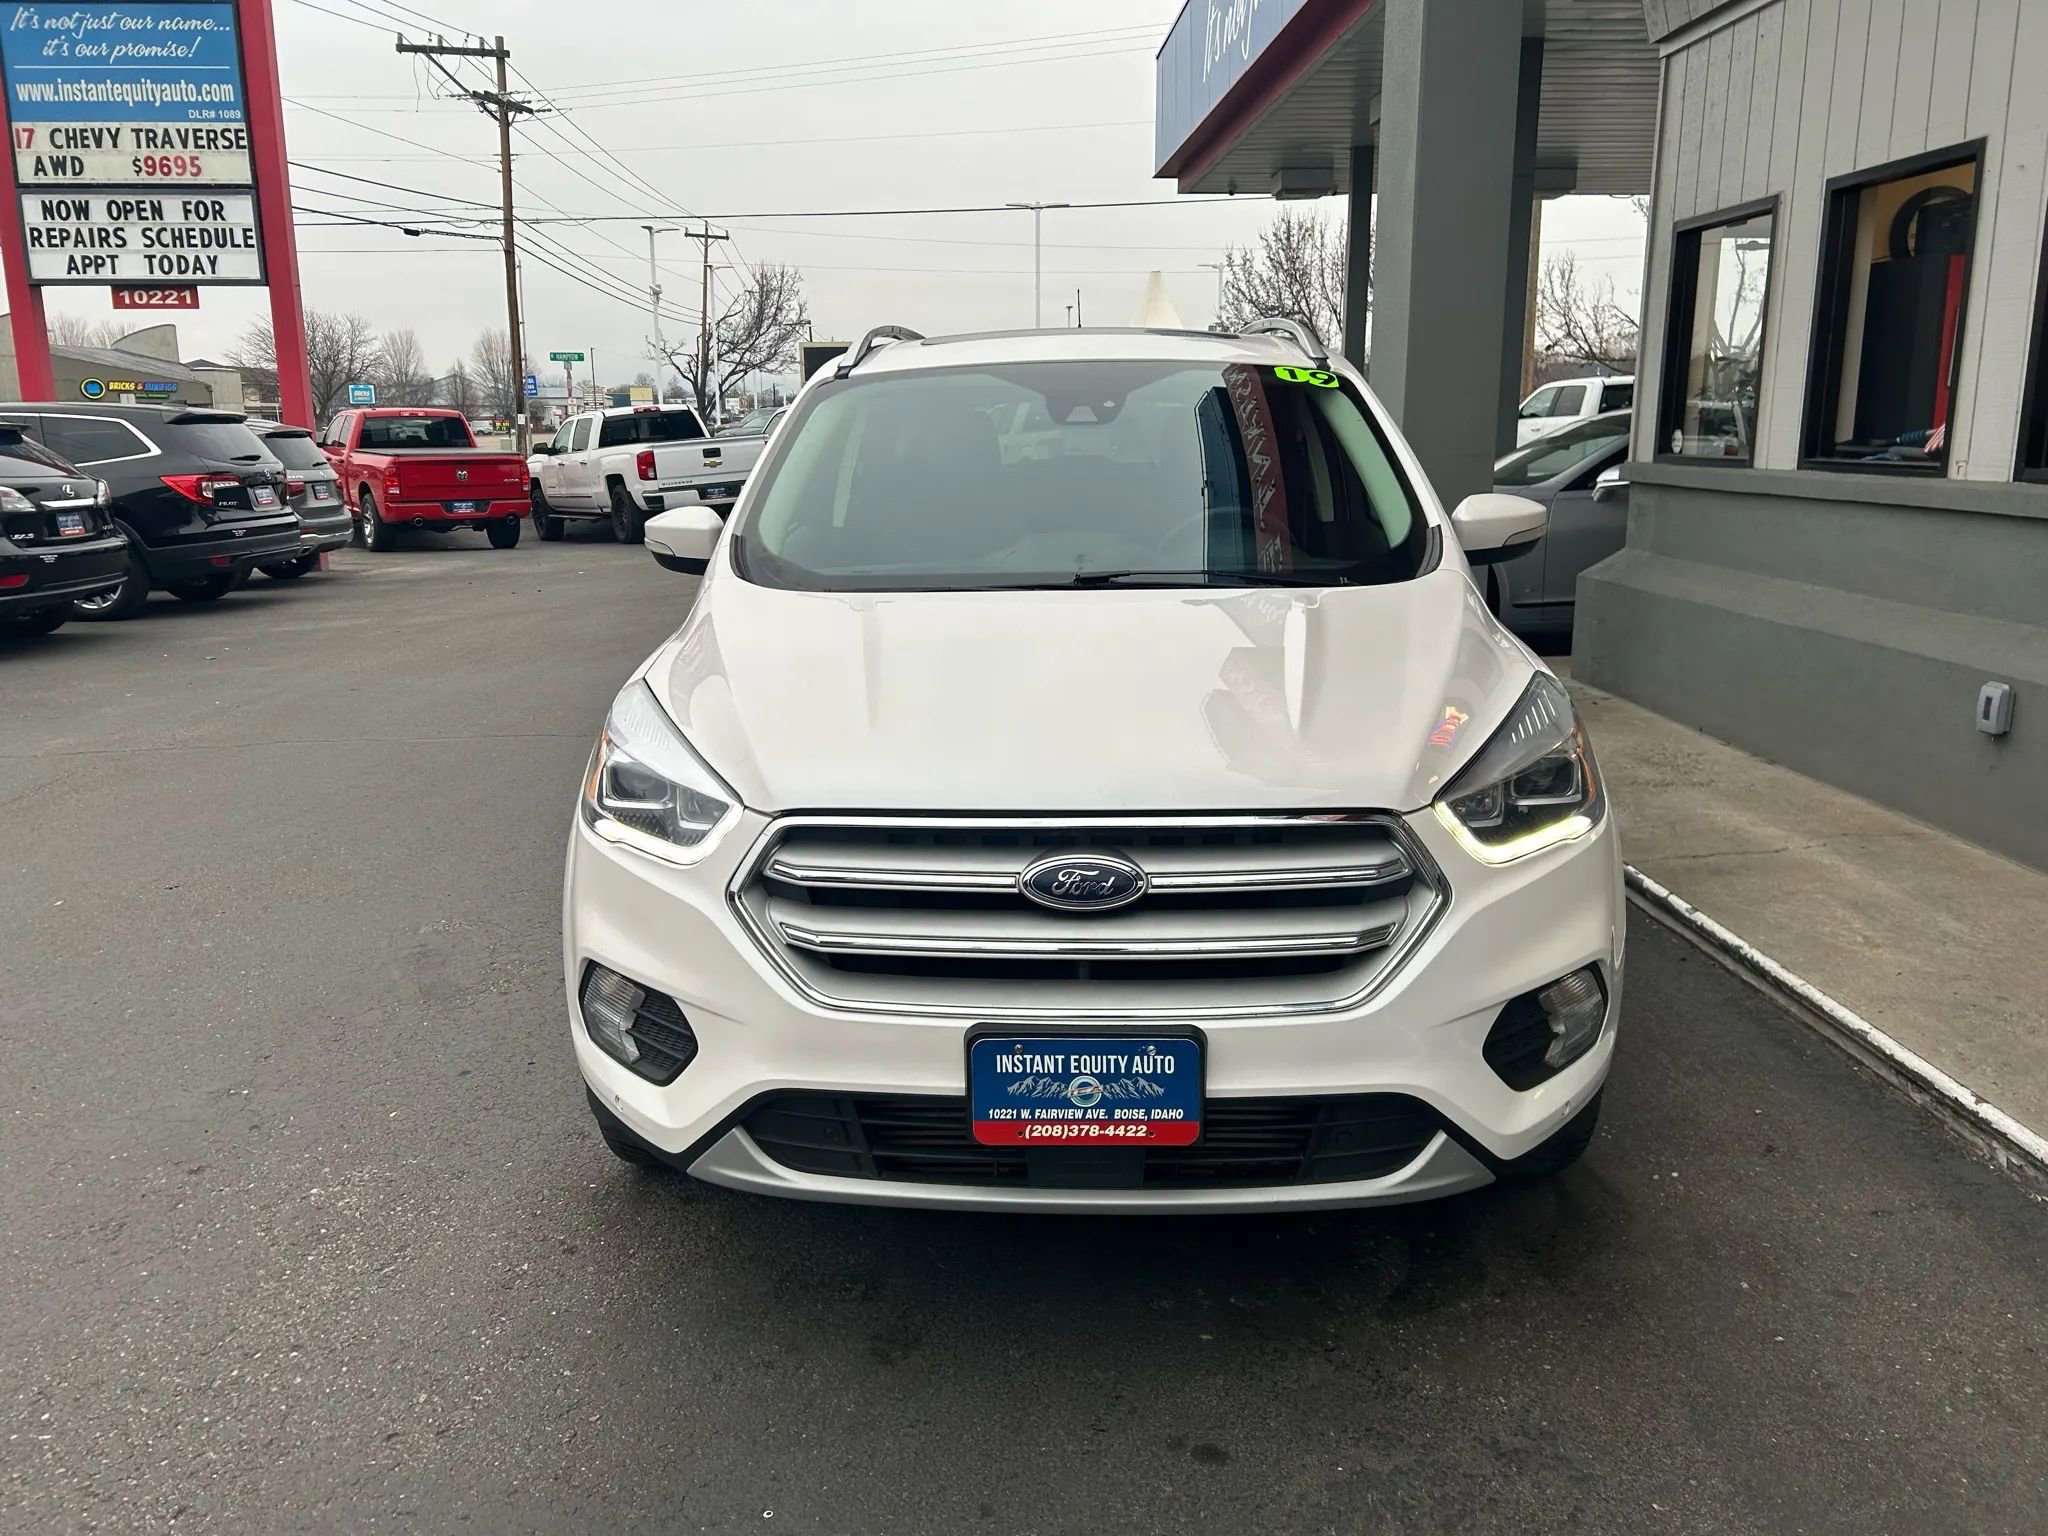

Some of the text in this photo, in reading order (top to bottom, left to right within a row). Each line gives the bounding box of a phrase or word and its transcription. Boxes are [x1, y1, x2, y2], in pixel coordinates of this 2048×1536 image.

[10, 6, 40, 32] It's
[44, 11, 83, 31] not
[72, 11, 121, 39] just
[120, 16, 154, 31] our
[42, 35, 202, 64] it's our promise!
[16, 78, 234, 107] www.instantequityauto.com
[188, 109, 241, 119] DLR# 1089
[15, 128, 248, 150] 17 CHEVY TRAVERSE
[33, 155, 202, 177] AWD $9695
[41, 200, 226, 221] NOW OPEN FOR
[29, 226, 256, 249] REPAIRS SCHEDULE
[66, 255, 219, 275] APPT TODAY
[119, 289, 193, 305] 10221
[108, 381, 136, 391] BRICKS
[1283, 367, 1336, 385] 19
[1051, 868, 1116, 897] Ford
[996, 1055, 1175, 1075] INSTANT EQUITY AUTO
[988, 1108, 1184, 1121] 10221 W. FAIRVIEW AVE. BOISE, IDAHO
[1025, 1125, 1147, 1139] (208)378-4422
